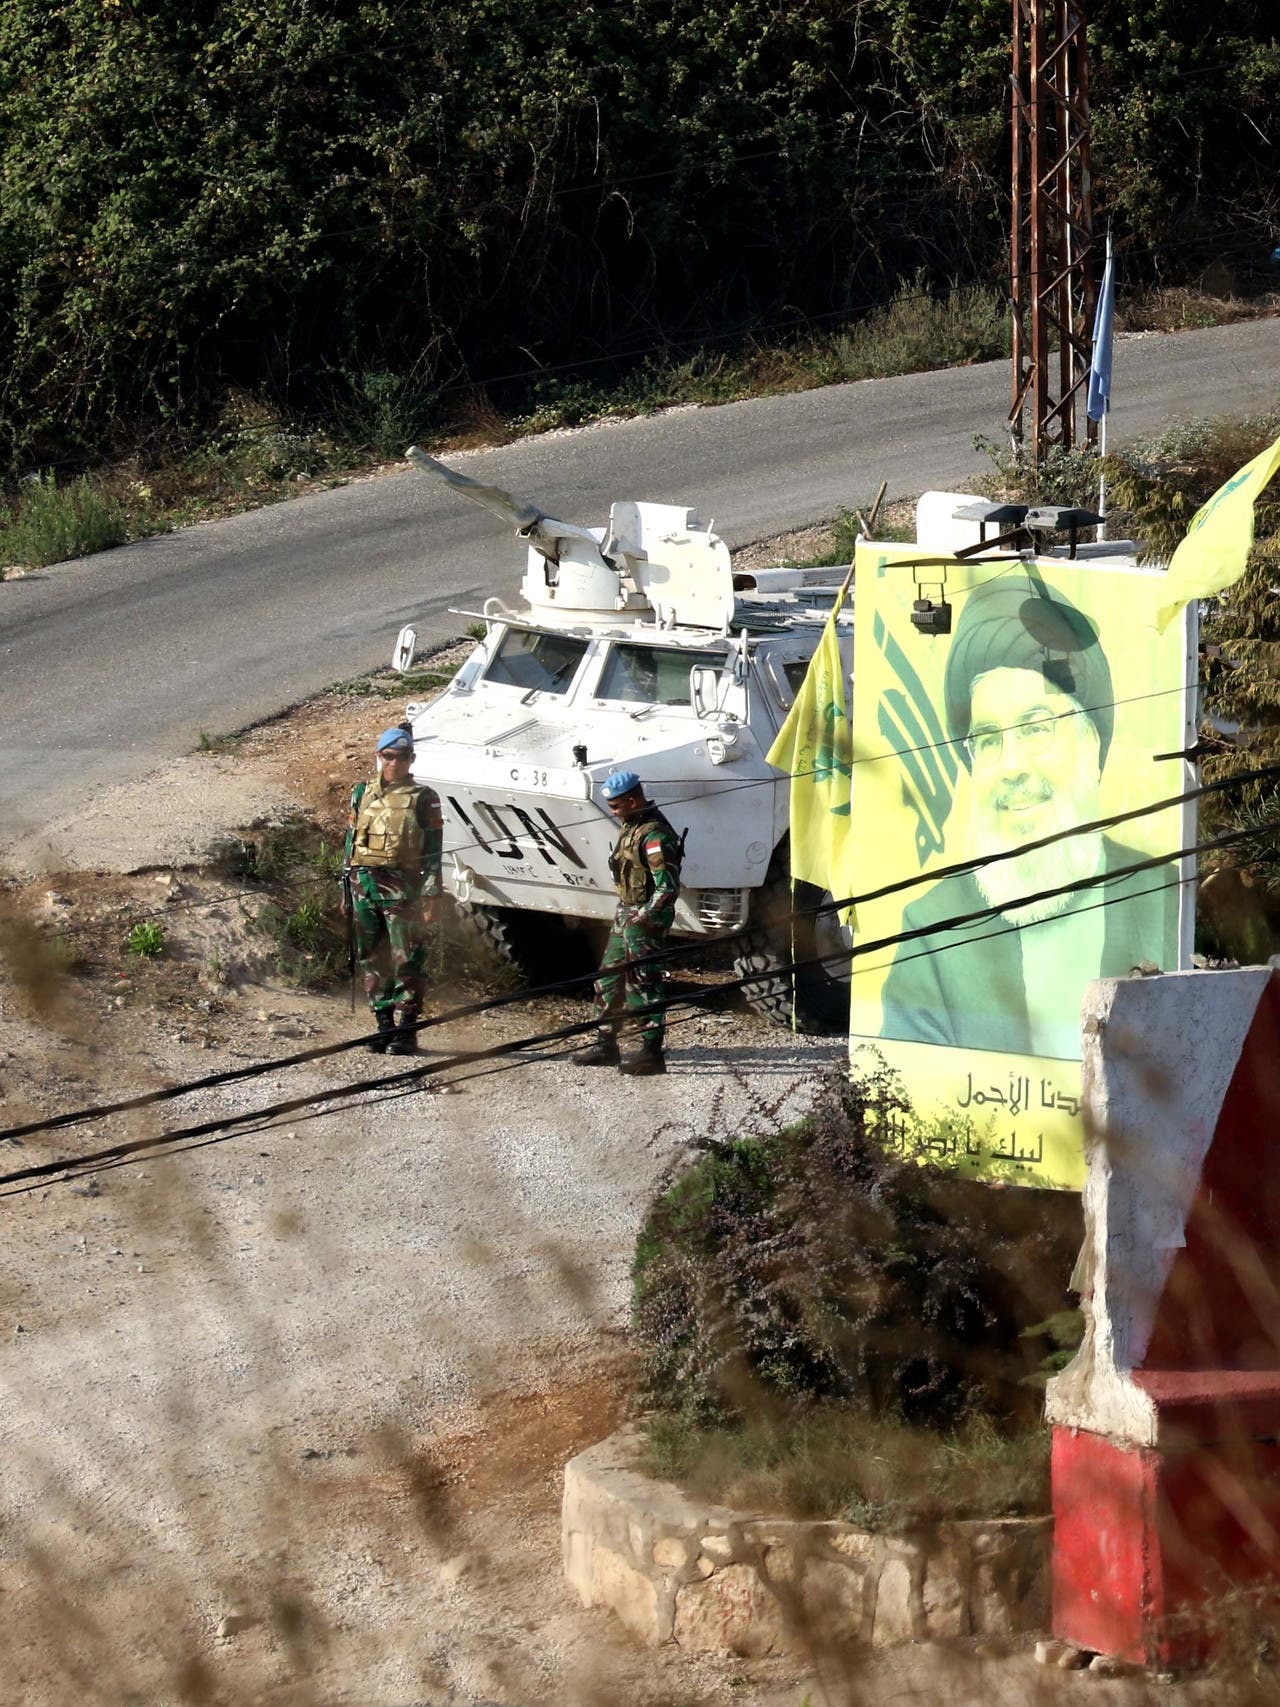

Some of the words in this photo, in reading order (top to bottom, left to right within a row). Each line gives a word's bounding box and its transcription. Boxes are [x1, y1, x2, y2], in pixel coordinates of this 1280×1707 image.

[510, 768, 519, 781] C
[533, 770, 548, 787] 38
[447, 796, 588, 869] UN
[957, 1071, 1029, 1116] الأجمل
